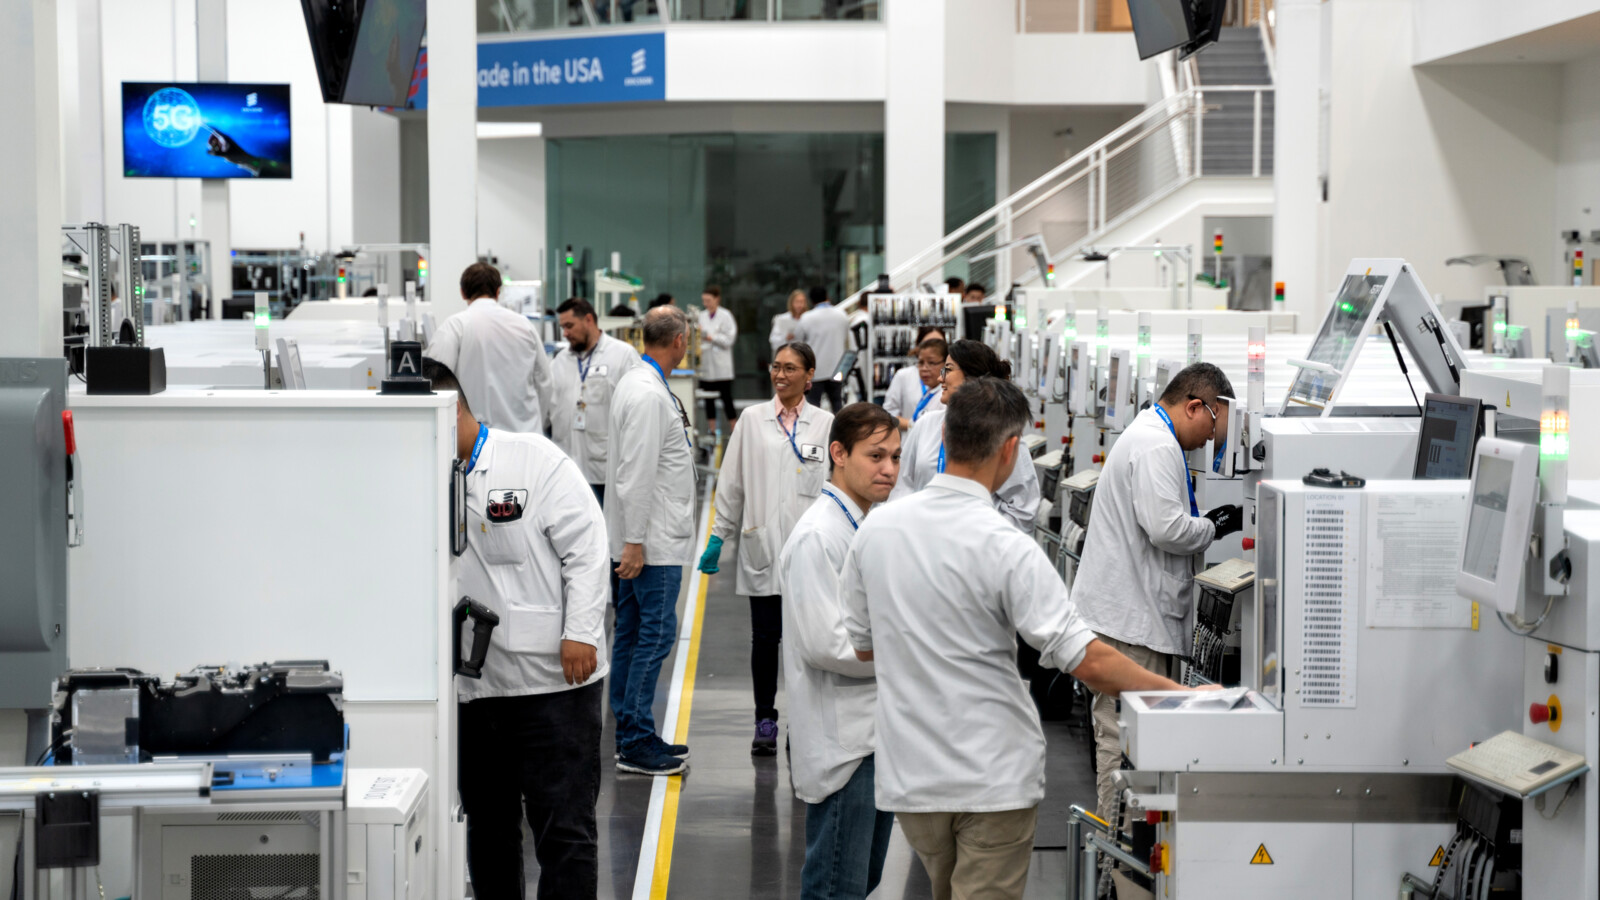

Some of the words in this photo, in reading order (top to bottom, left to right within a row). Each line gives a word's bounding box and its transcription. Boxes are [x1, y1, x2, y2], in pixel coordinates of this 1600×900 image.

[477, 62, 510, 87] ade
[513, 61, 530, 85] in
[532, 59, 561, 85] the
[564, 56, 604, 83] USA
[152, 104, 194, 131] 5G
[397, 351, 416, 373] A
